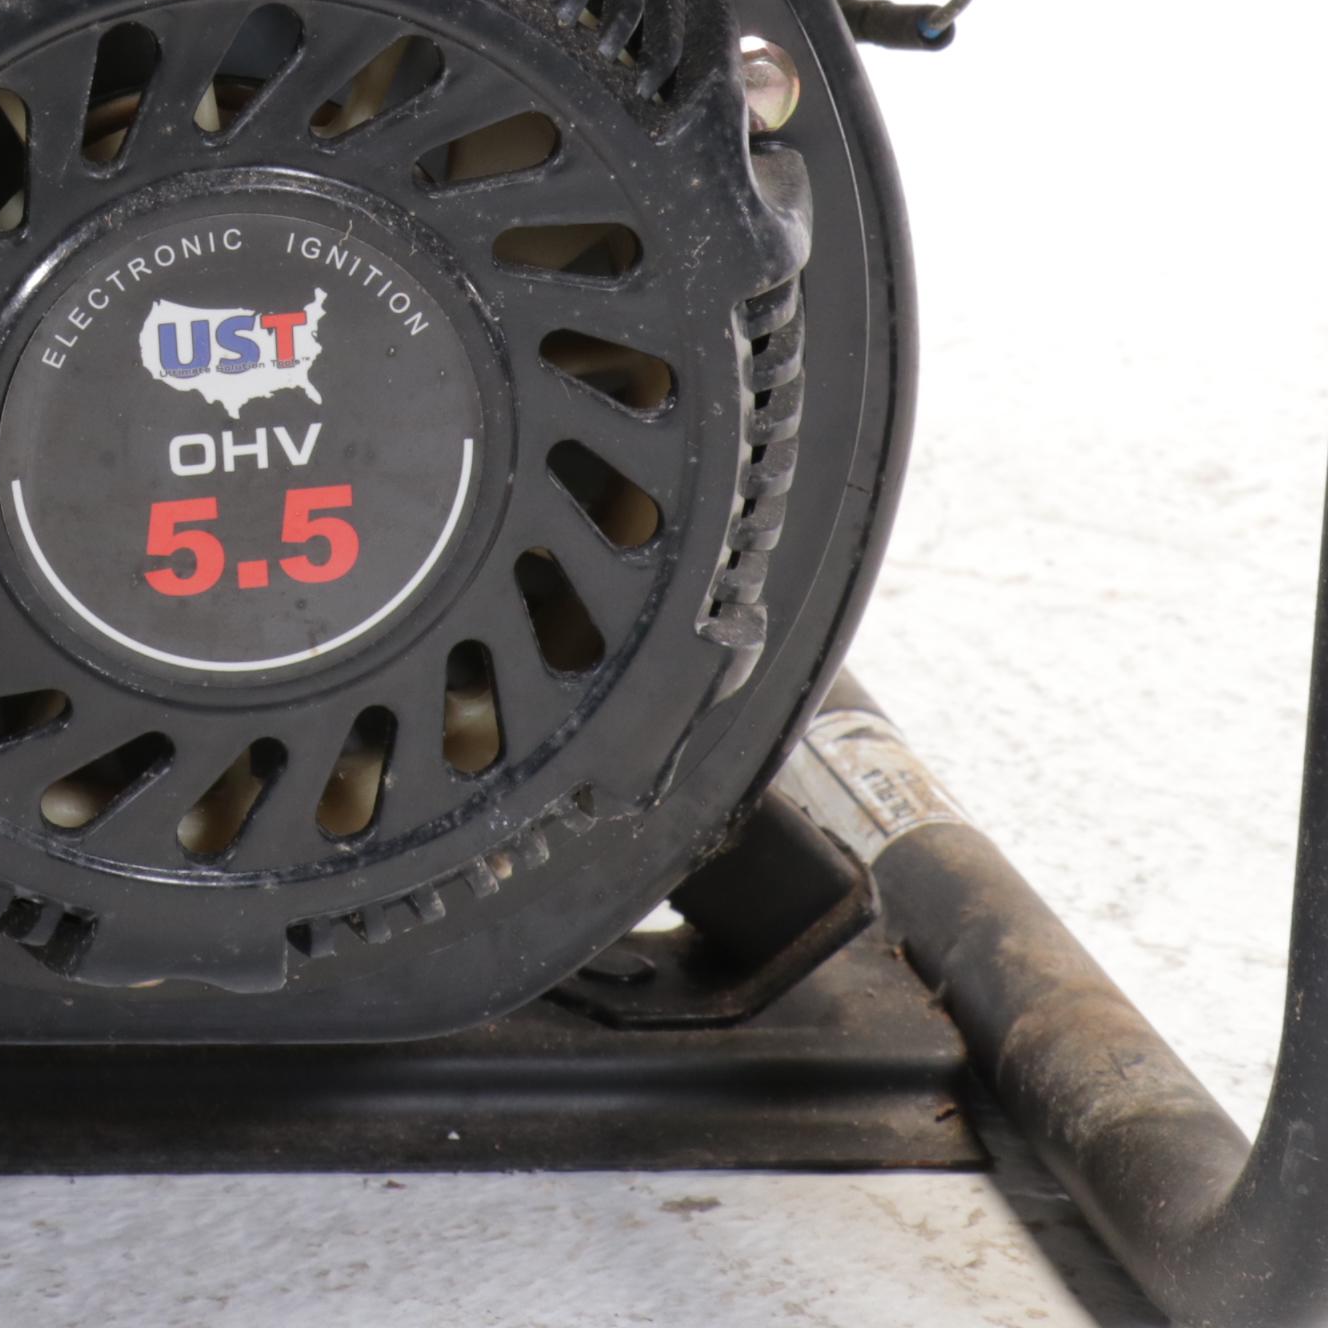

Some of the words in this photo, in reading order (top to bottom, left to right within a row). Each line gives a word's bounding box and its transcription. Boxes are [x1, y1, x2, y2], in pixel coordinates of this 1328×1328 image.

[41, 227, 243, 370] ELECTRONIC
[285, 231, 430, 338] IGNITION
[157, 310, 308, 379] UST
[169, 422, 322, 476] OHV
[143, 483, 361, 597] 5.5
